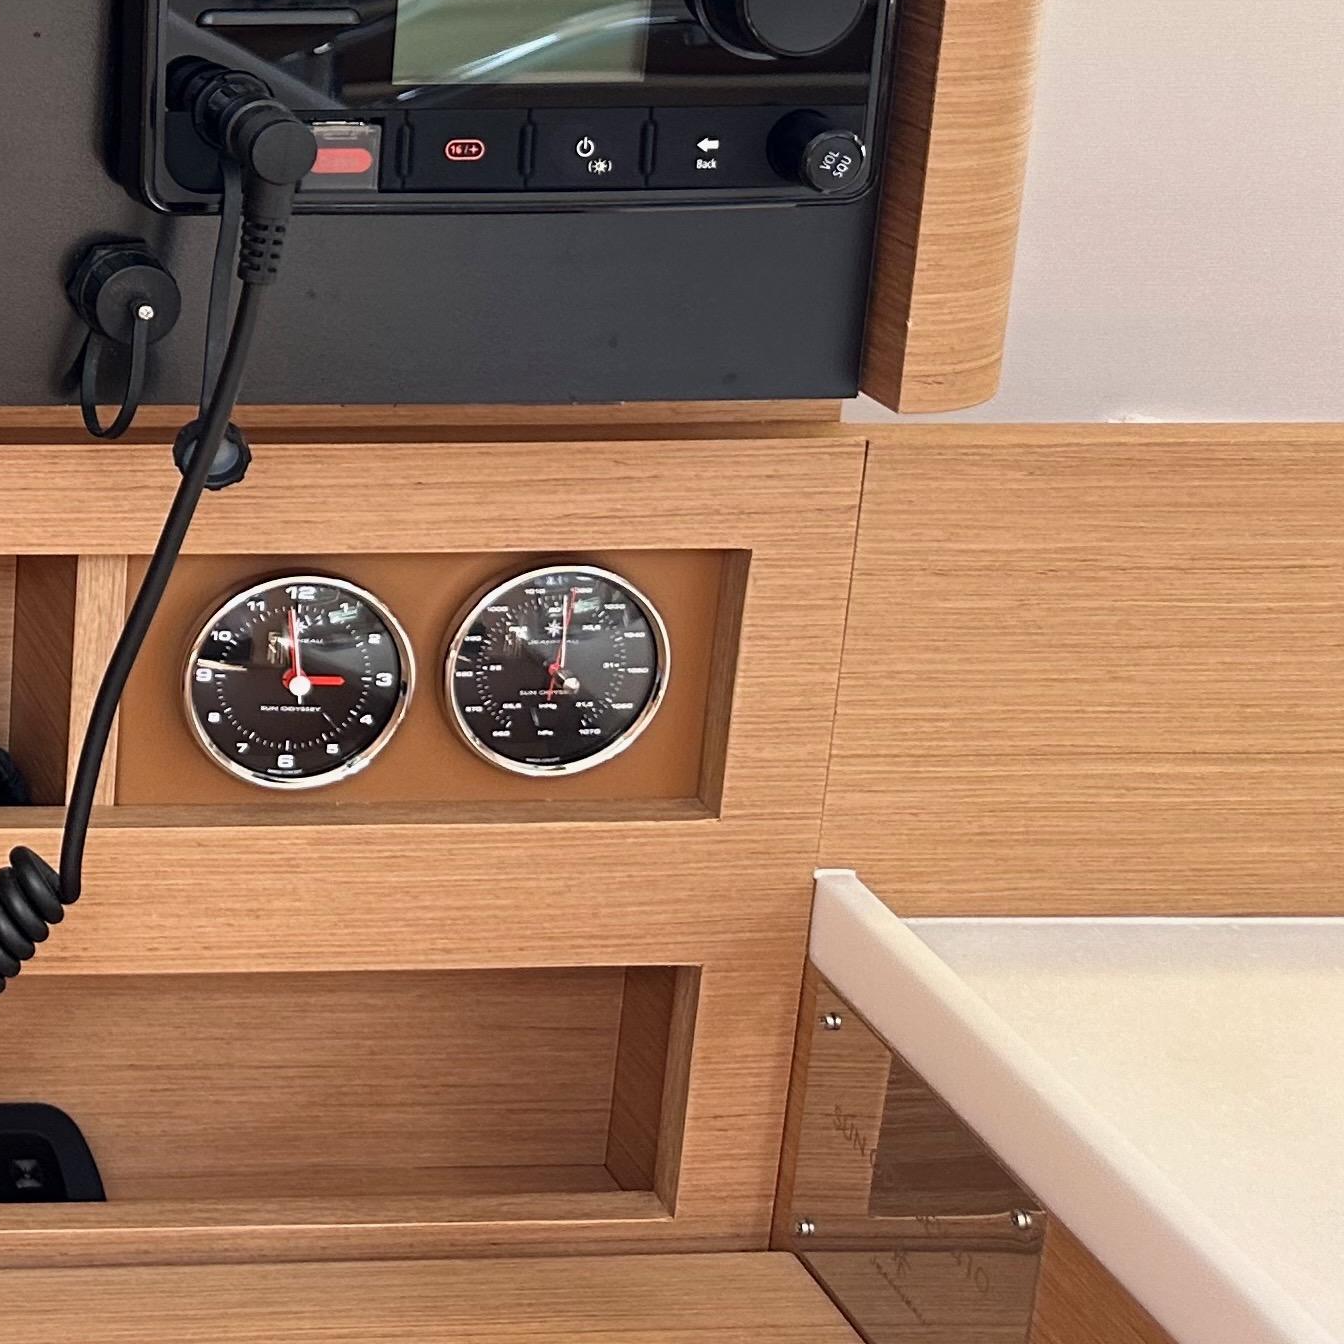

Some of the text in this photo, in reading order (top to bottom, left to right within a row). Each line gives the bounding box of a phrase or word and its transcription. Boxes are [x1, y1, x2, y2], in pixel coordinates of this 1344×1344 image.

[696, 159, 717, 170] Back
[819, 150, 840, 171] VOL
[832, 155, 852, 178] SQU
[285, 587, 316, 600] 12
[247, 601, 265, 612] 11
[211, 630, 232, 641] 10
[196, 668, 213, 682] 9
[375, 672, 393, 687] 3
[360, 714, 373, 726] 4
[236, 742, 249, 753] 7
[326, 743, 339, 754] 5
[277, 754, 294, 768] 6
